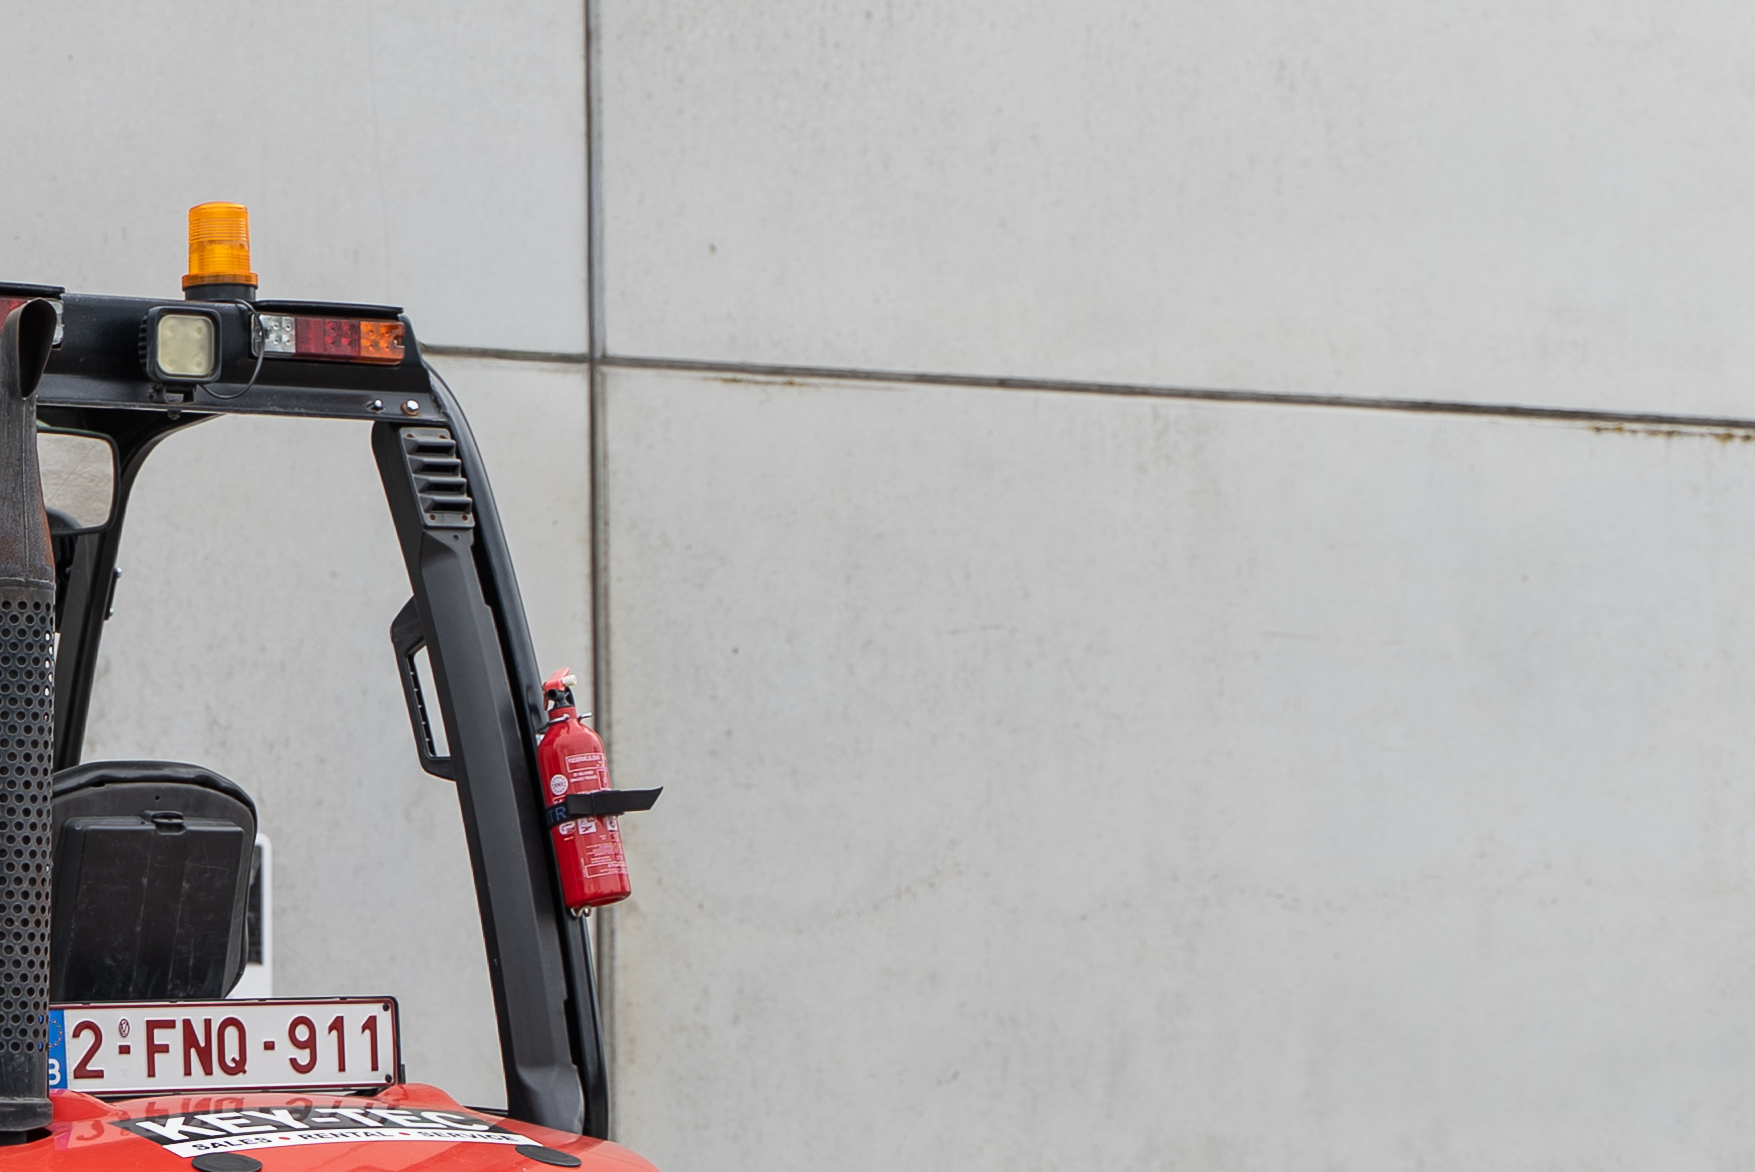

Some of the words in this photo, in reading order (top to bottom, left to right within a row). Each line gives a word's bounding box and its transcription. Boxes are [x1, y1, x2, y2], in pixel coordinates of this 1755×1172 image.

[135, 1109, 490, 1142] KEY-TEC
[192, 1136, 272, 1151] SALES
[298, 1130, 395, 1141] RENTAL
[418, 1130, 520, 1143] SERVICE
